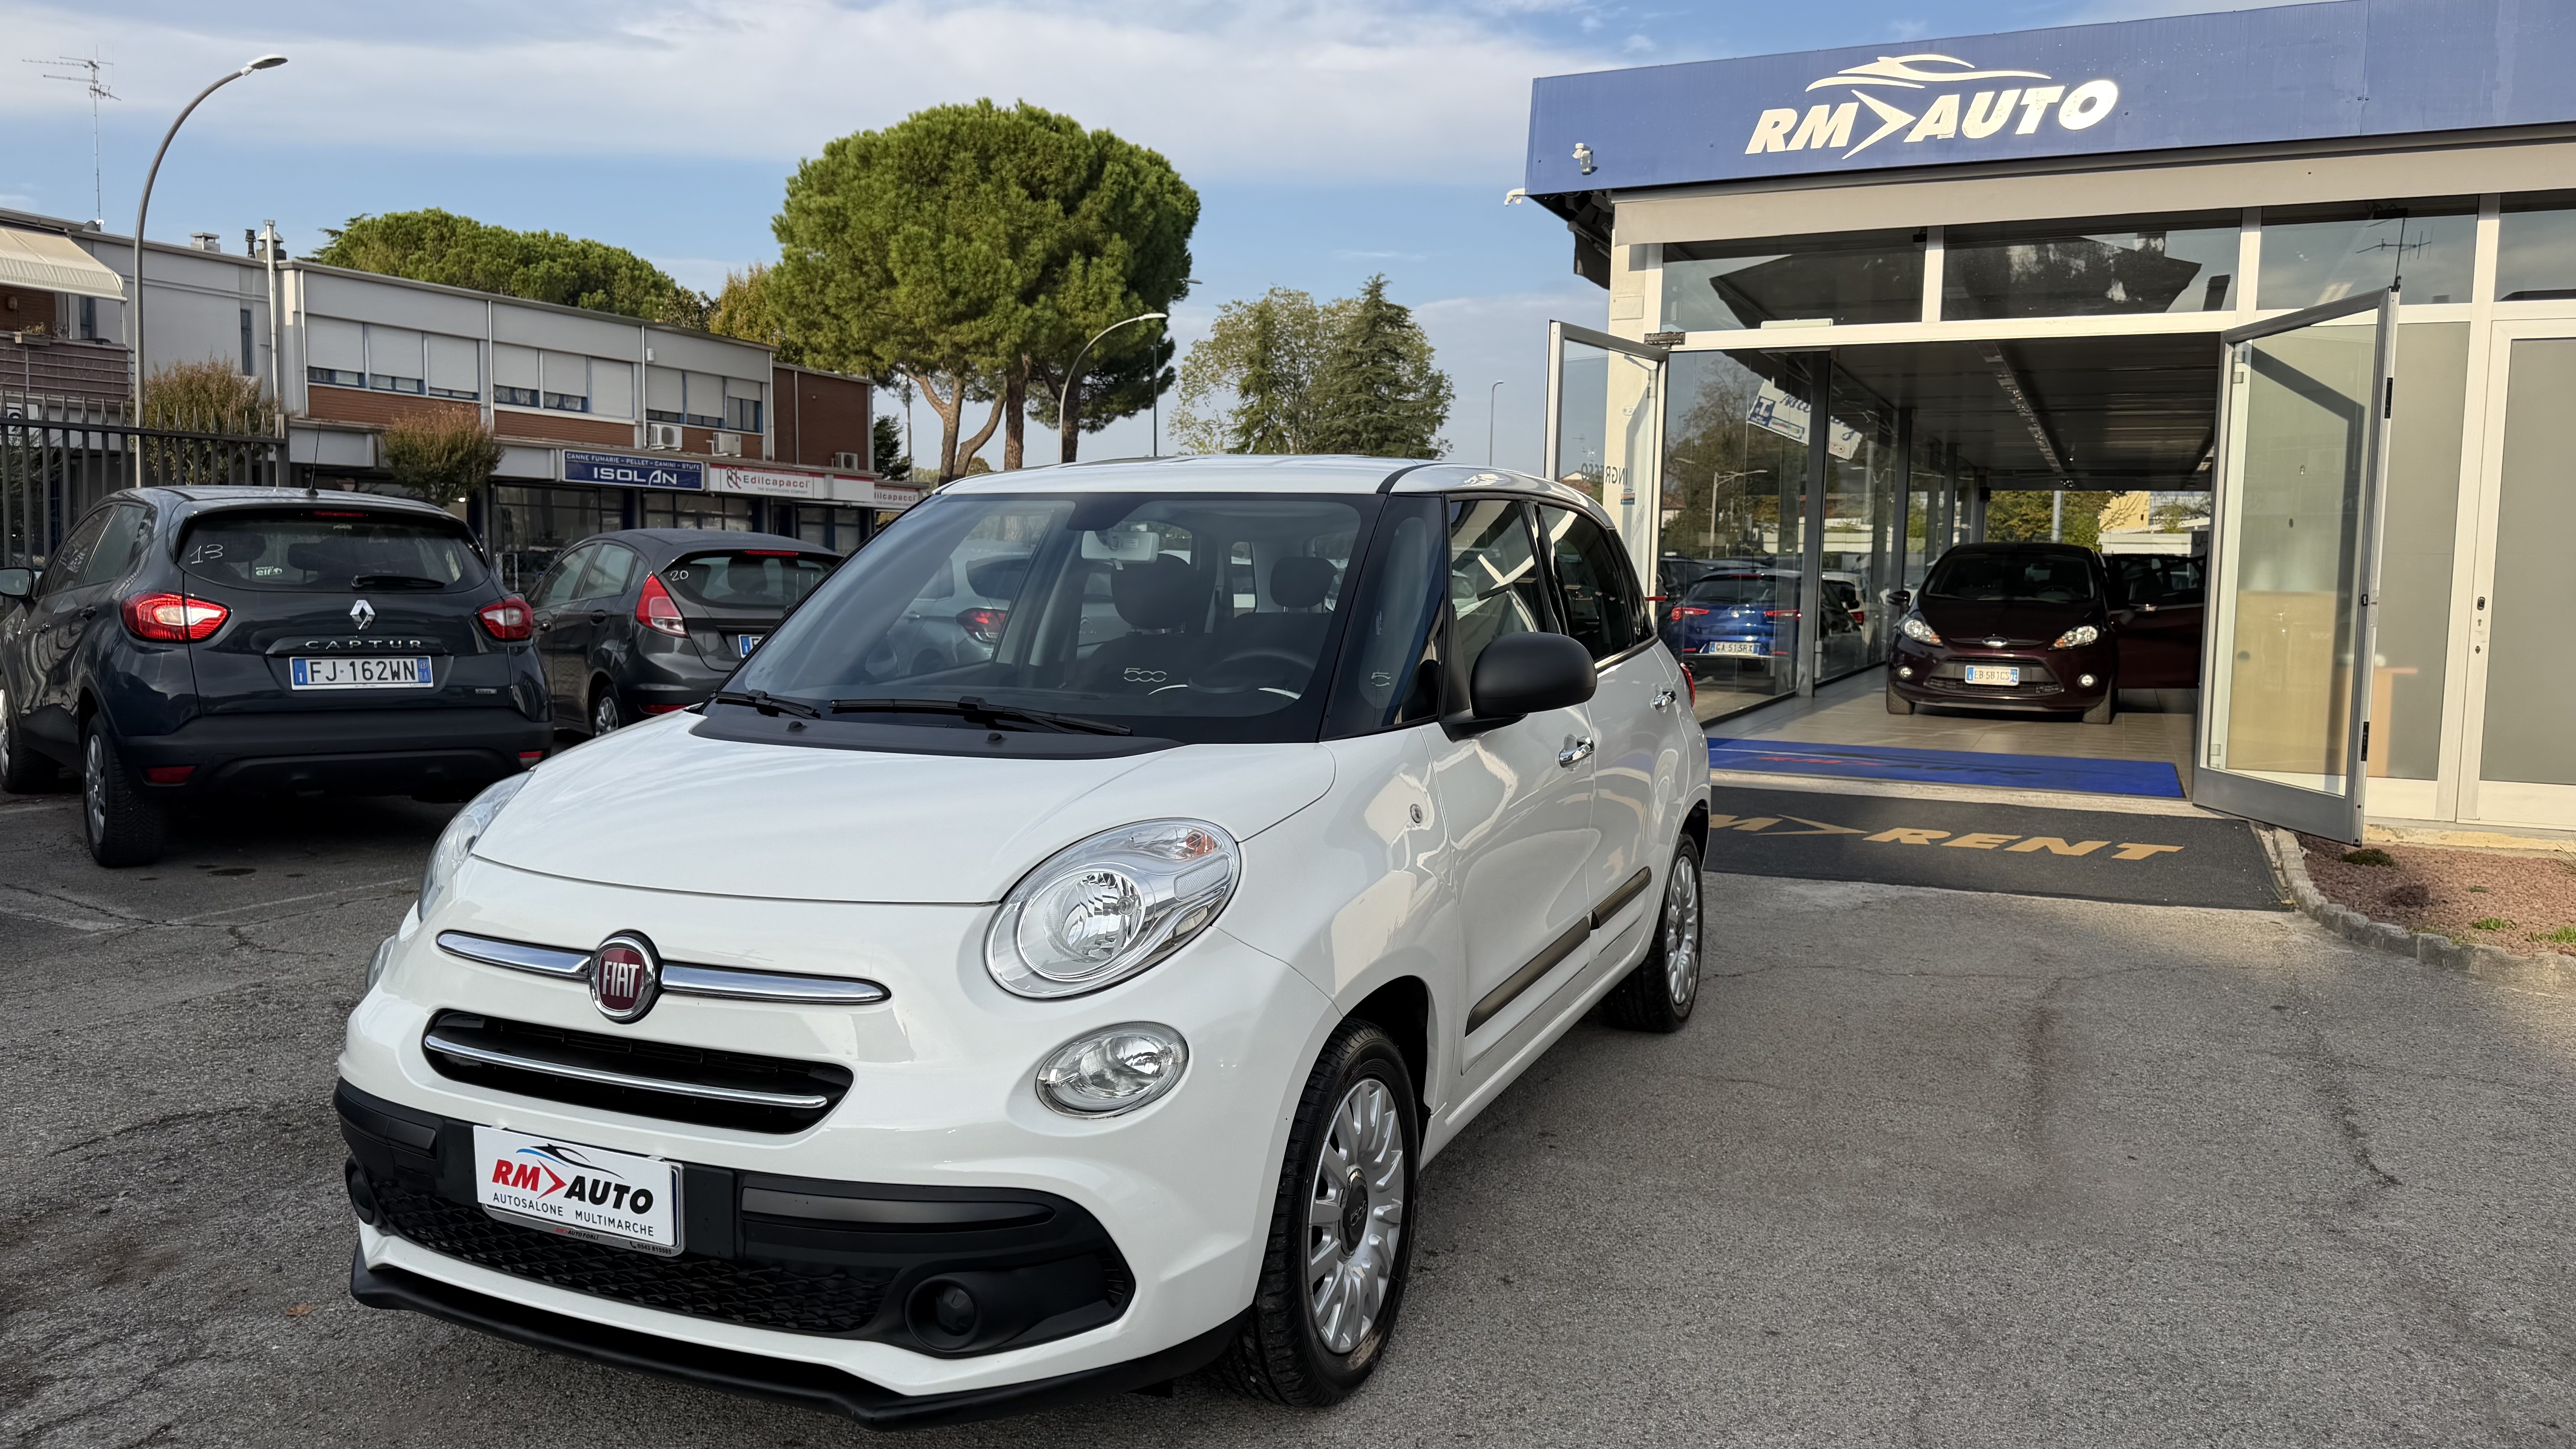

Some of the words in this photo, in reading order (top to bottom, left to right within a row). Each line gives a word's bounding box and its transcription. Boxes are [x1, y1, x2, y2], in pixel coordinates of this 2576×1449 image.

[1745, 102, 1859, 155] RM
[1904, 80, 2118, 143] AUTO
[566, 453, 589, 461] CANNE
[591, 455, 620, 464] FUMARIE
[593, 467, 677, 486] ISOLAN
[743, 474, 809, 489] Edilcapacci
[874, 492, 915, 501] ilcapacci
[189, 543, 223, 564] 13
[670, 570, 689, 581] 20
[305, 640, 422, 649] CAPTUR
[310, 661, 337, 682] FJ
[349, 660, 416, 681] 162WN
[1123, 667, 1167, 682] 500
[1710, 814, 1783, 831] M
[1863, 827, 2184, 860] RENT
[602, 961, 640, 998] FIAT
[492, 1159, 541, 1192] RM
[564, 1175, 653, 1214] AUTO
[492, 1192, 563, 1216] AUTOSALONE
[575, 1210, 654, 1237] MULTIMARCHE
[637, 1243, 651, 1251] 0543
